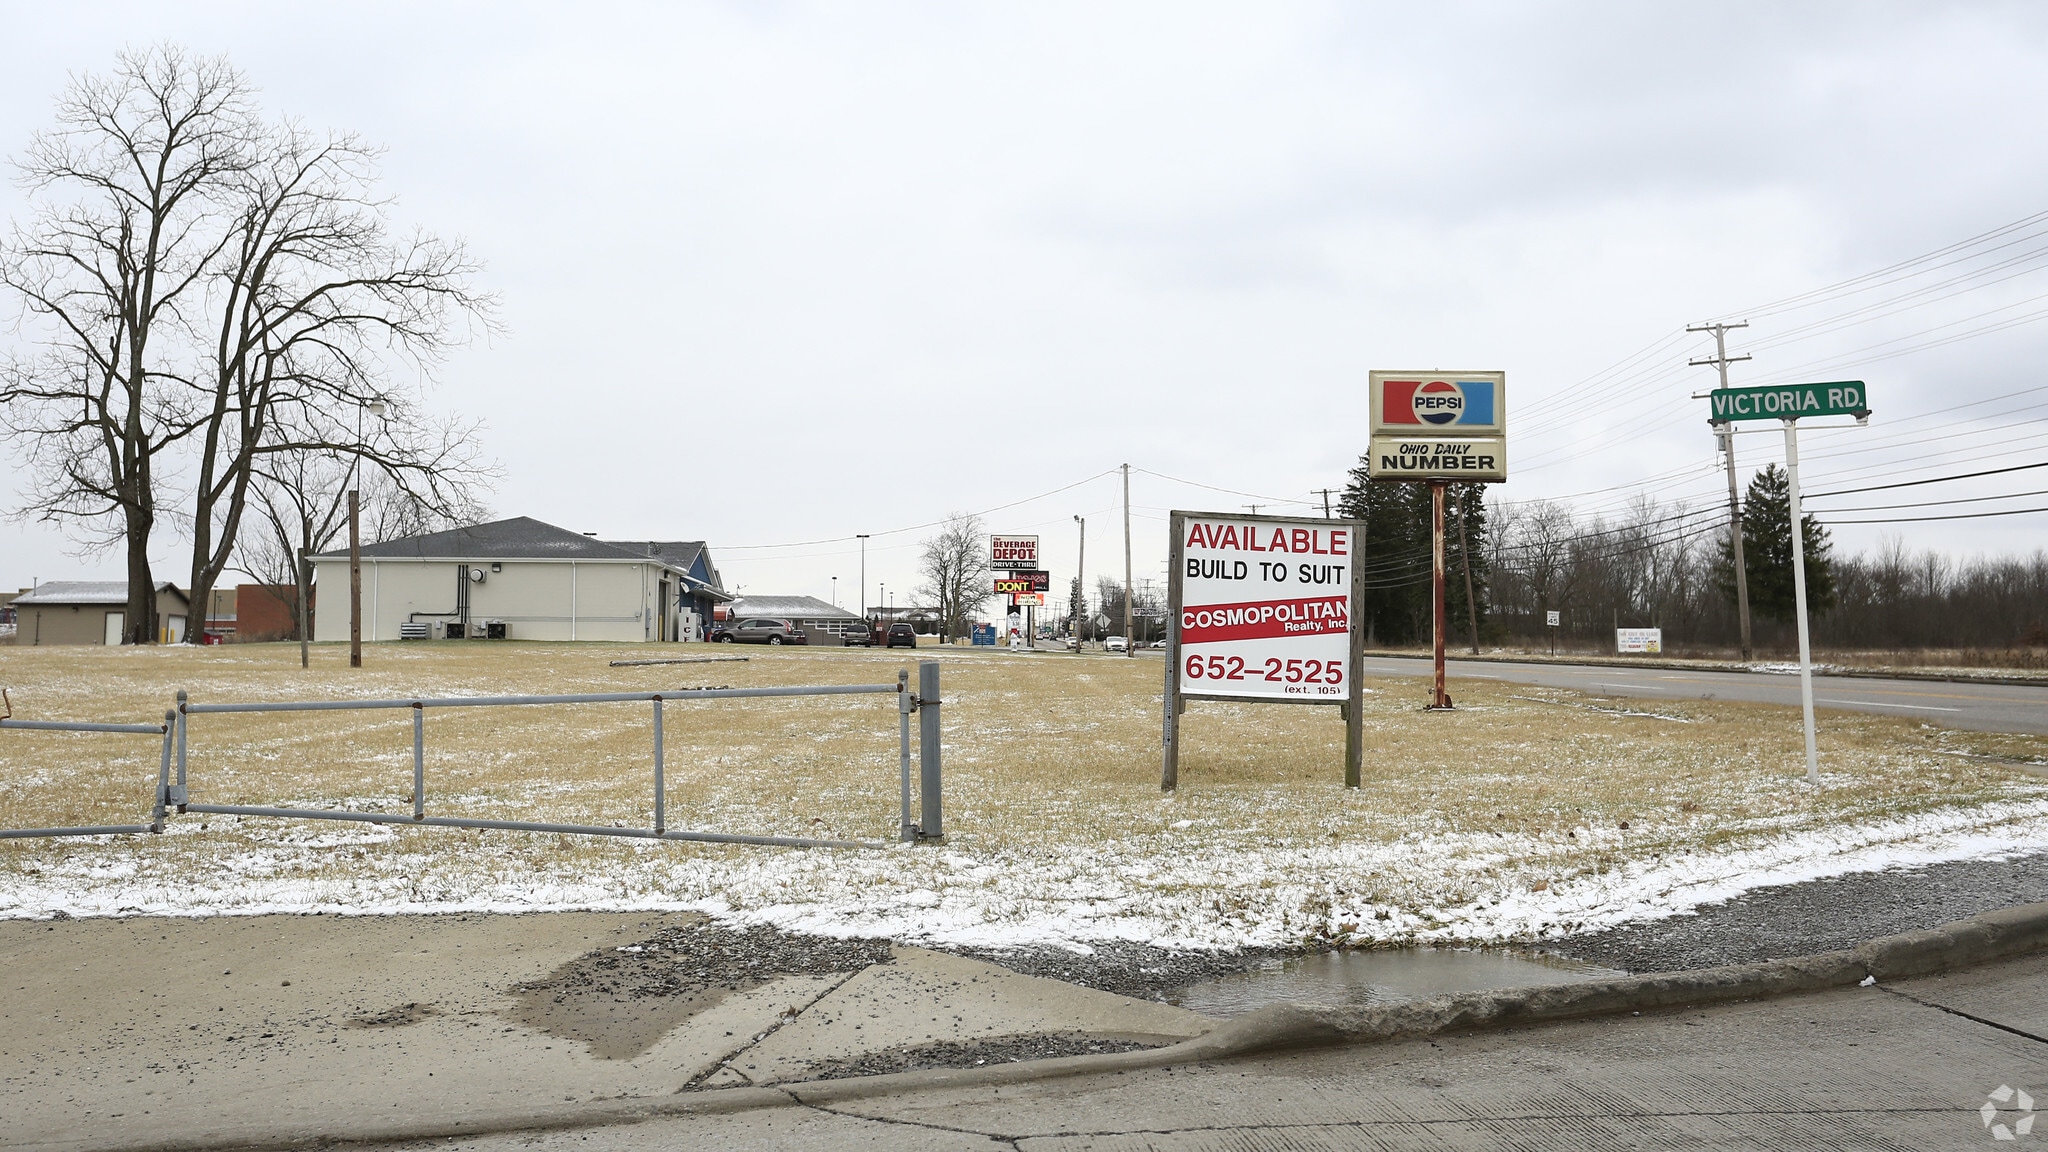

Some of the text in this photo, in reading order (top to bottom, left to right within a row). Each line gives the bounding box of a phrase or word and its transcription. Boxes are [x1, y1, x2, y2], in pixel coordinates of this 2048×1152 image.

[1415, 397, 1462, 409] PEPSI
[1713, 387, 1864, 415] VICTORIA RD.
[1399, 443, 1471, 455] OHIO DAILY
[1382, 455, 1495, 470] NUMBER
[1186, 523, 1347, 556] AVAILABLE
[1187, 558, 1345, 585] BUILD TO SUIT
[997, 581, 1030, 592] DONT
[1182, 600, 1348, 630] COSMOPOLITAN
[1284, 620, 1324, 633] Realty,
[1185, 654, 1343, 685] 652-2525
[1284, 684, 1341, 695] (ext. 105)
